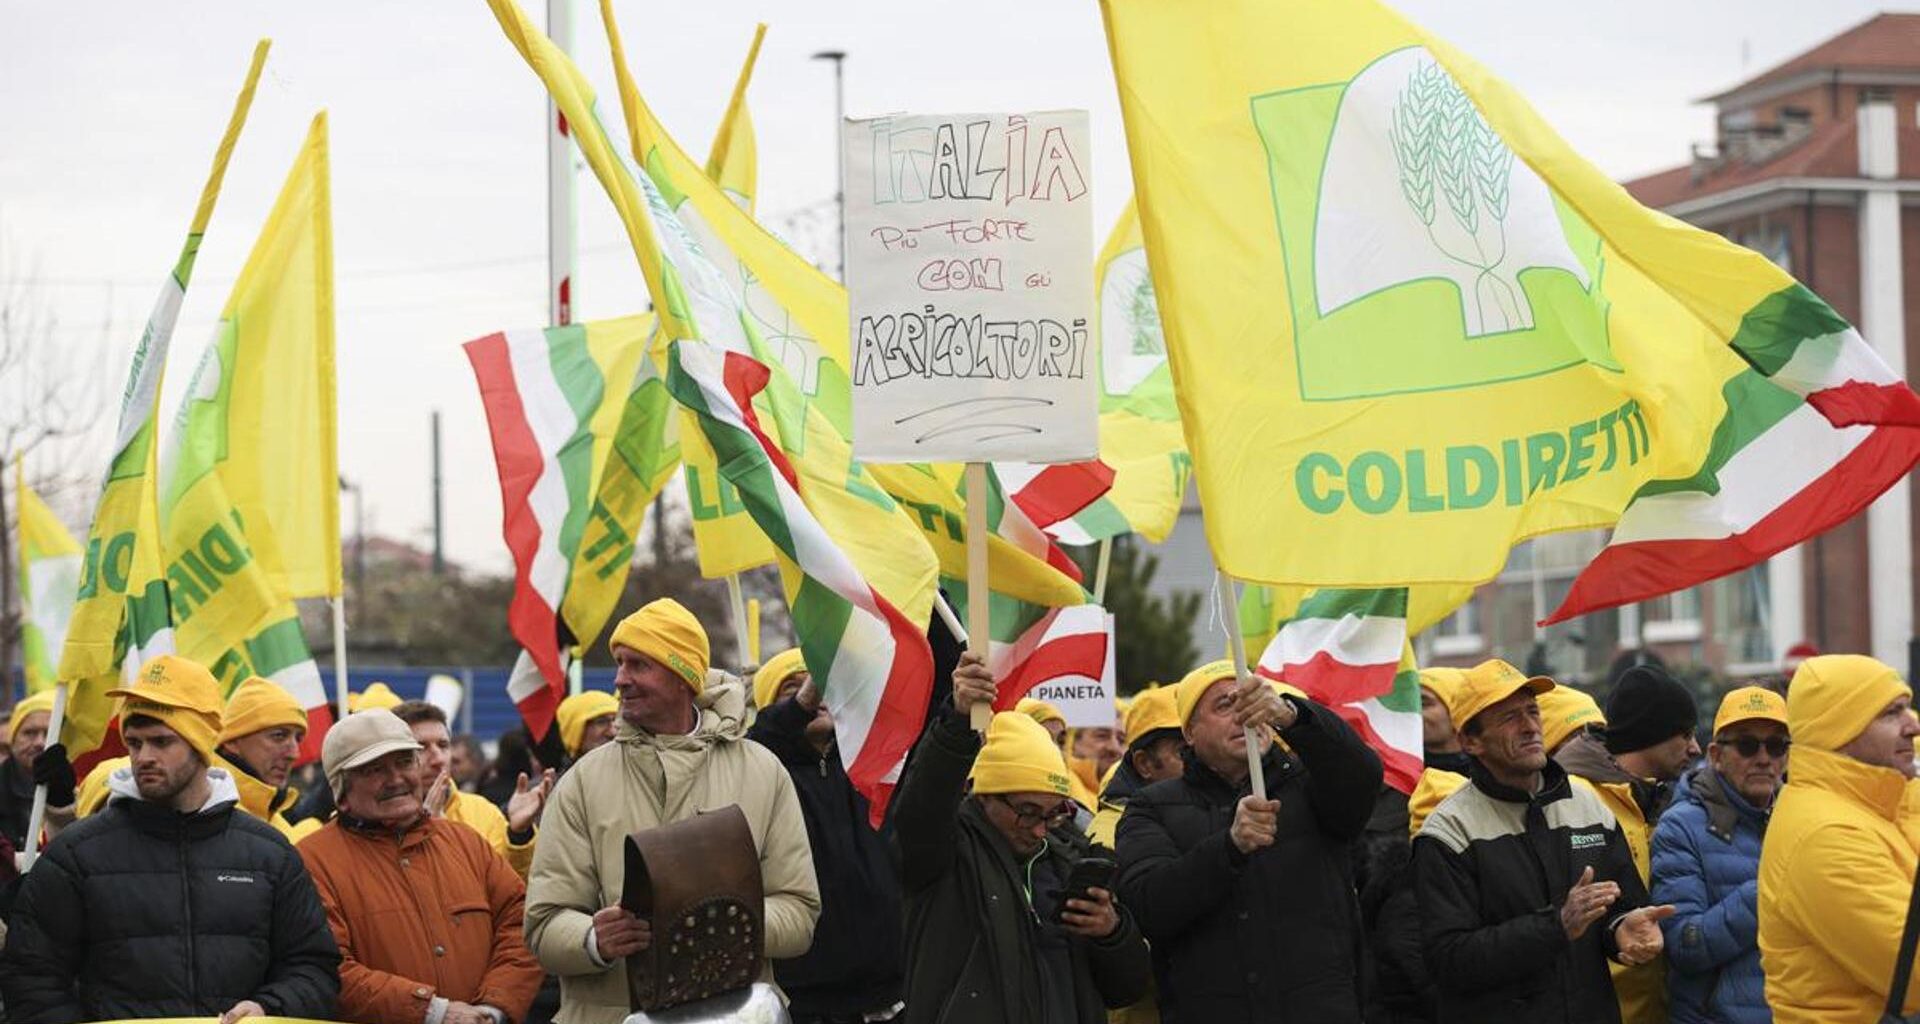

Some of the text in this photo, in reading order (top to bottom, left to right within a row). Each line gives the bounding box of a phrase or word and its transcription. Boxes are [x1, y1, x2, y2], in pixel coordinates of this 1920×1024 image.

[870, 115, 1088, 206] ITALIA
[923, 219, 1035, 244] FORTE
[917, 258, 1004, 291] CON
[854, 304, 1088, 386] AGRICOLTORI
[1295, 398, 1650, 515] COLDIRETTI
[1039, 686, 1104, 700] PIANETA
